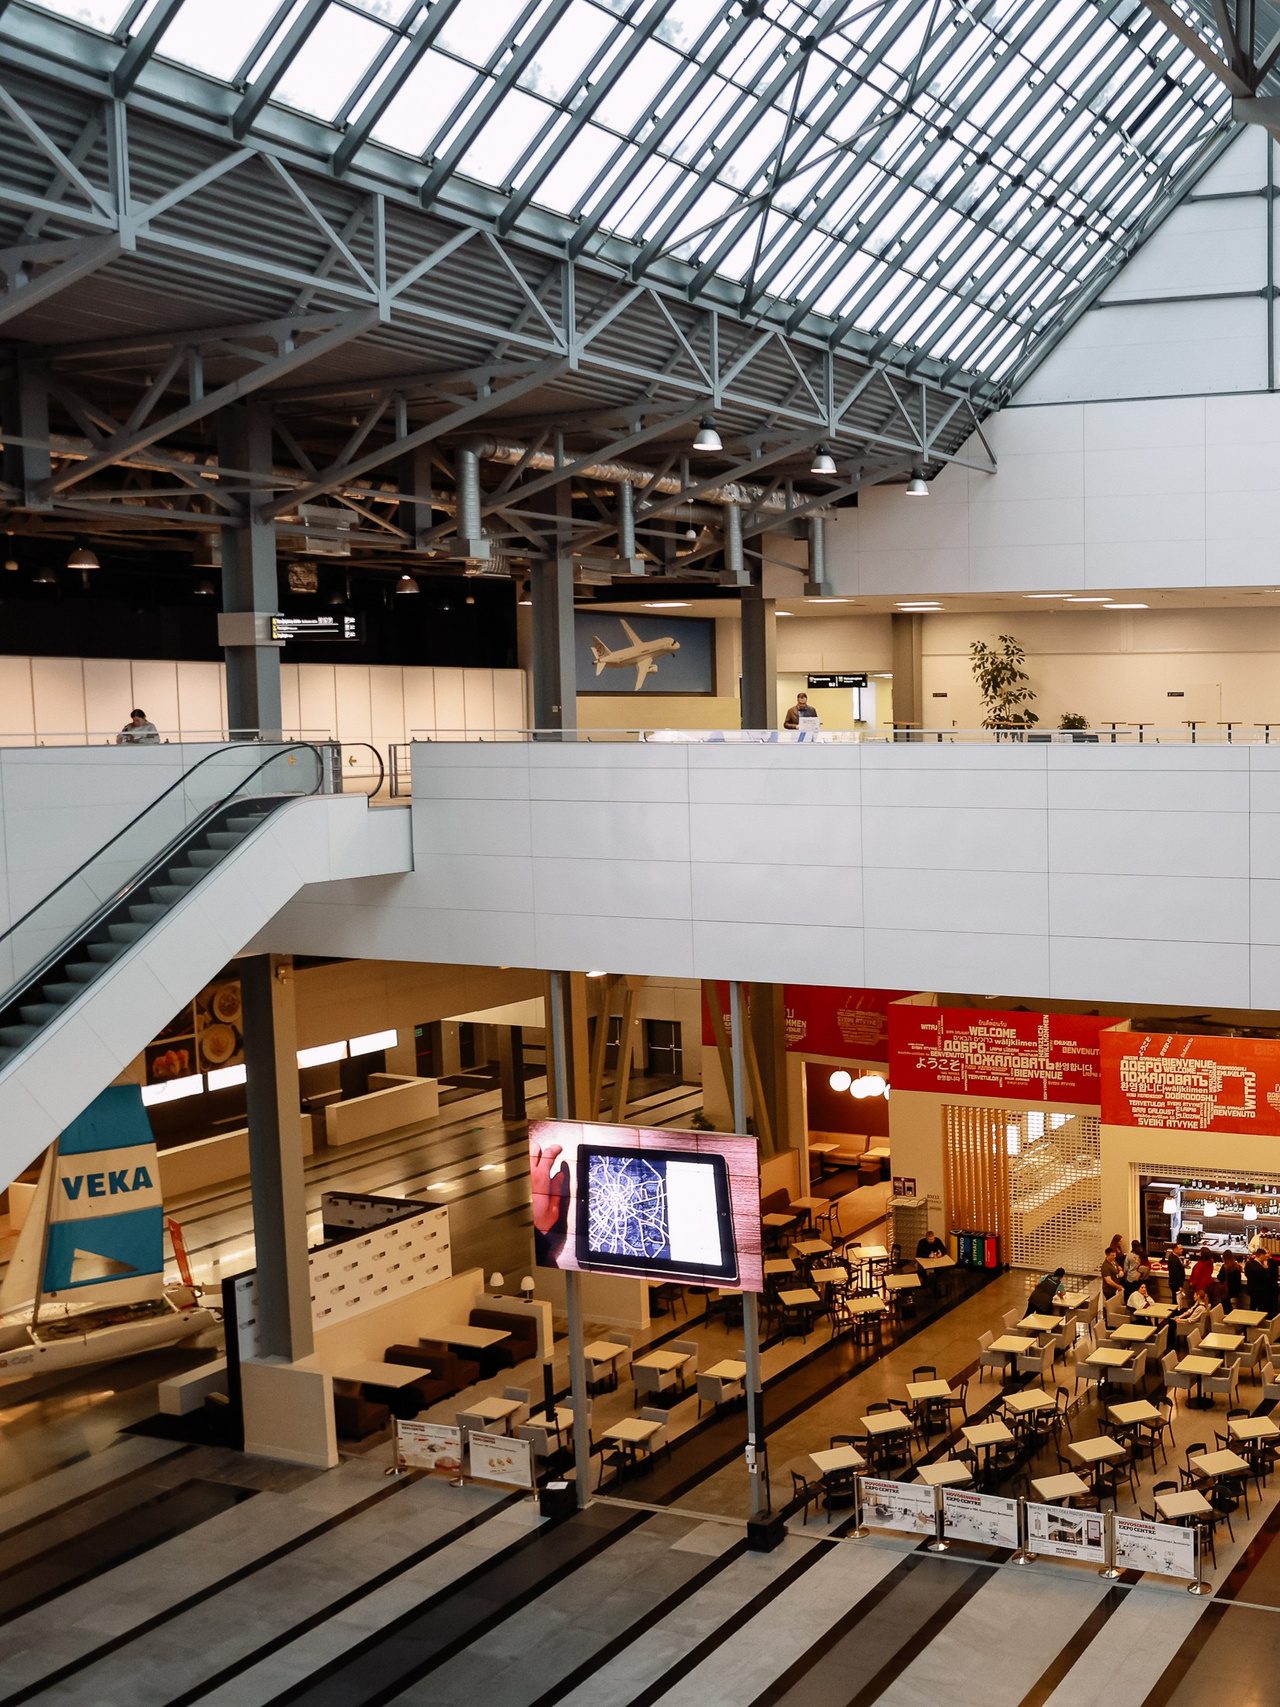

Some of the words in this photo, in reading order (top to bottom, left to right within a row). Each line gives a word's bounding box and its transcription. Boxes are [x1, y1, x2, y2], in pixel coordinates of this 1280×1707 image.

[969, 1026, 1017, 1038] WELCOME
[943, 1040, 986, 1054] ДОБРО
[1062, 1047, 1100, 1055] BENVENUT
[930, 1050, 965, 1059] BENVENUTO
[916, 1057, 960, 1072] ようこそ
[965, 1053, 1054, 1070] ПОЖАЛОВАТЬ
[1120, 1059, 1162, 1073] ДОБРО
[1162, 1057, 1213, 1069] BIENVENUE
[1014, 1068, 1063, 1080] BIENVENUE
[1120, 1071, 1208, 1087] ПОЖАЛОВАТЬ
[1244, 1072, 1256, 1110] WITAJ
[1214, 1110, 1256, 1118] BENVENUTO
[1138, 1117, 1164, 1127] SVEIKI
[1166, 1119, 1199, 1129] ATVYKE
[61, 1165, 153, 1201] VEKA
